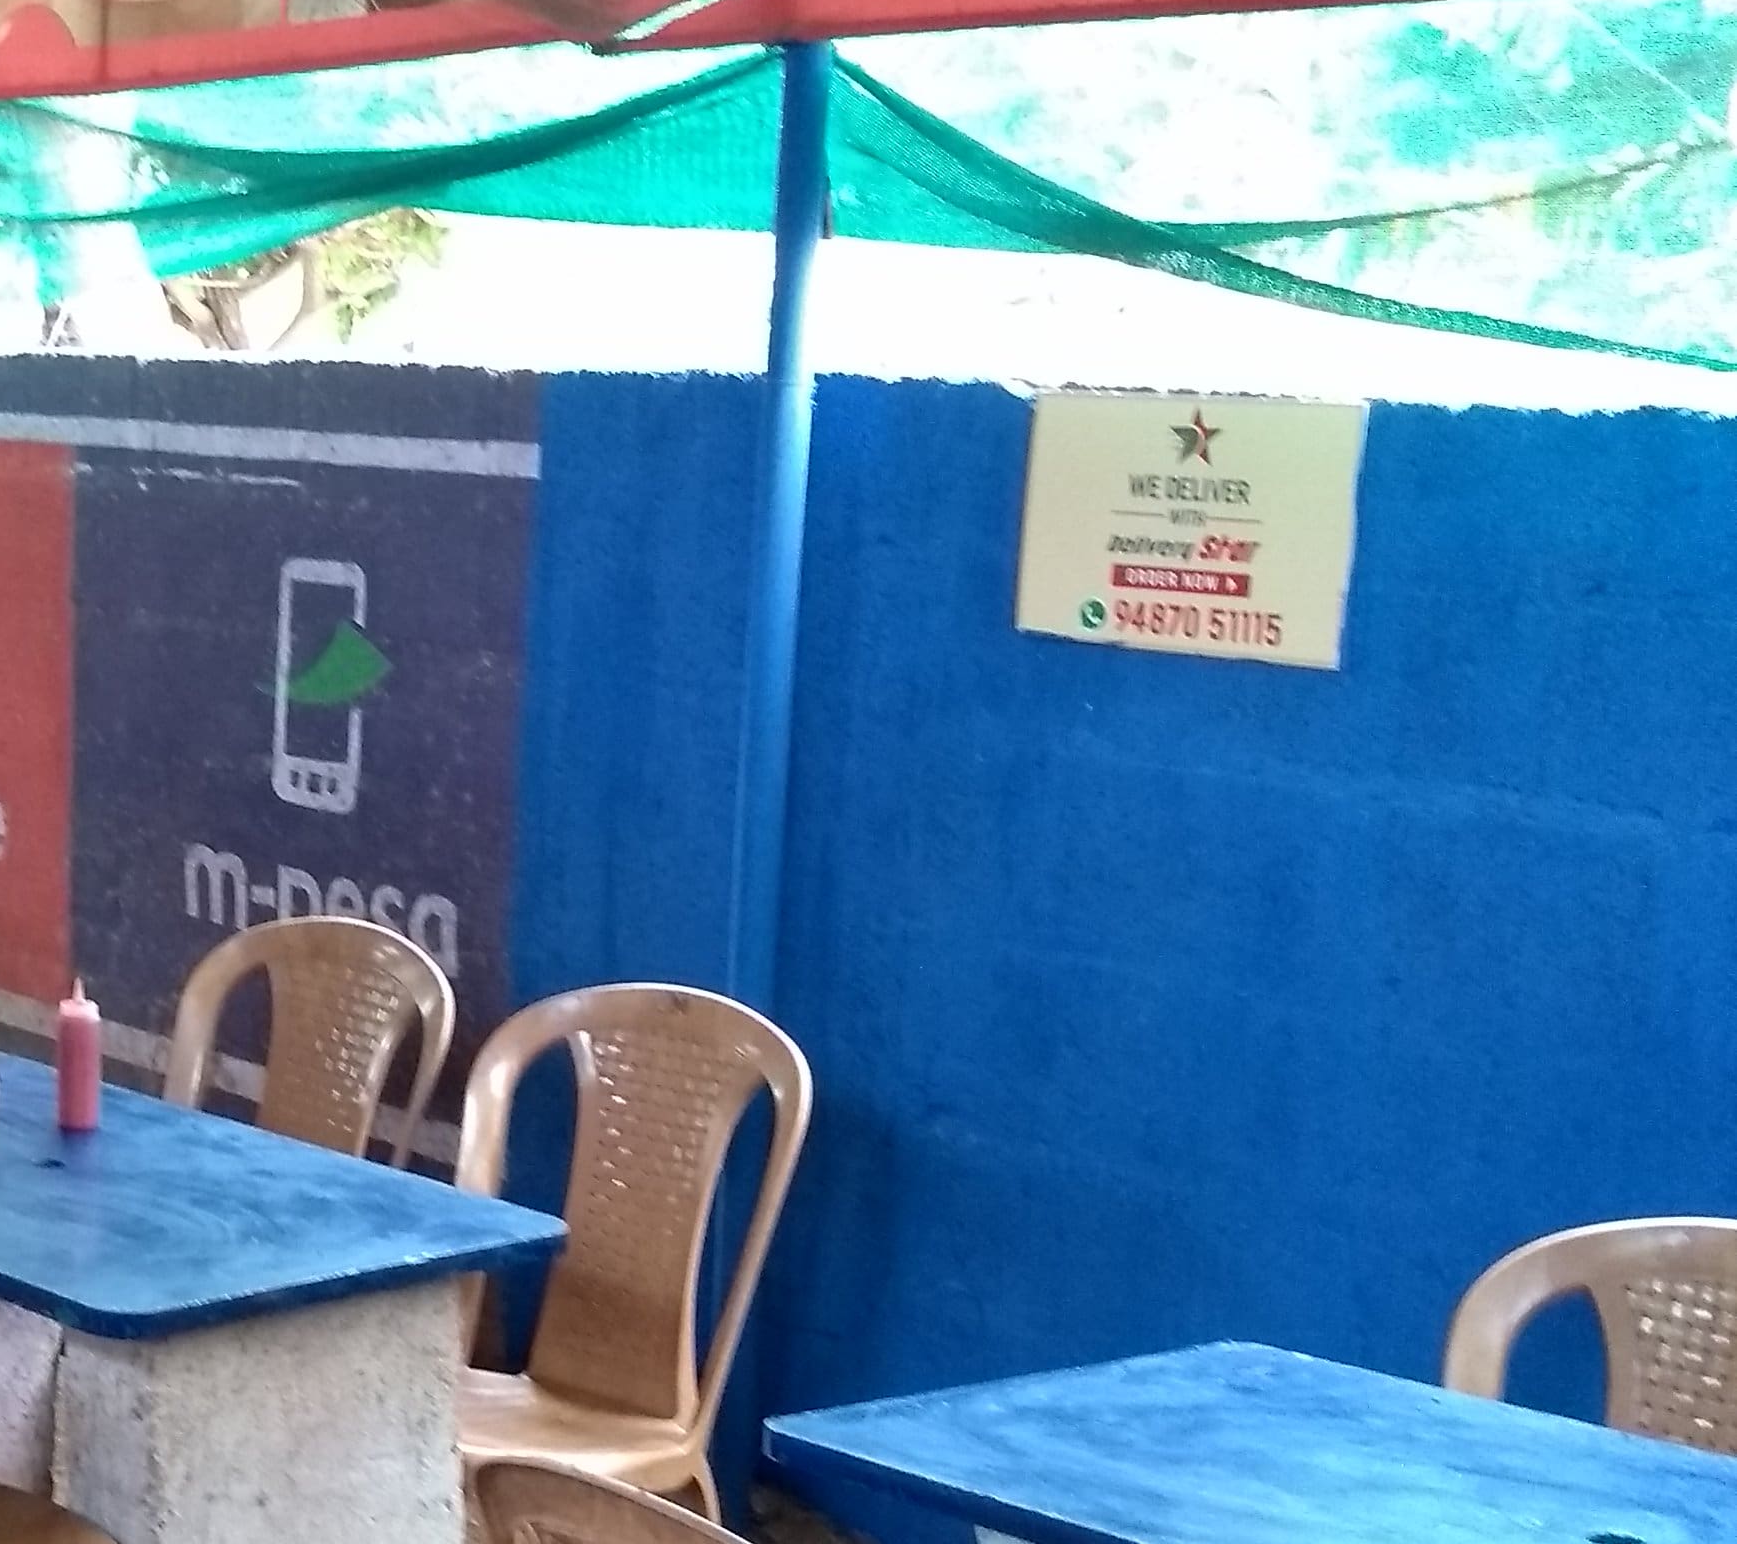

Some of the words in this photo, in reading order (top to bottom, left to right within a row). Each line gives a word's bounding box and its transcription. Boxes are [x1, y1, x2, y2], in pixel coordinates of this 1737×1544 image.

[1165, 476, 1252, 505] DELIVER
[1180, 572, 1220, 592] NOW
[1114, 599, 1201, 639] 94870
[1208, 607, 1284, 647] 51115
